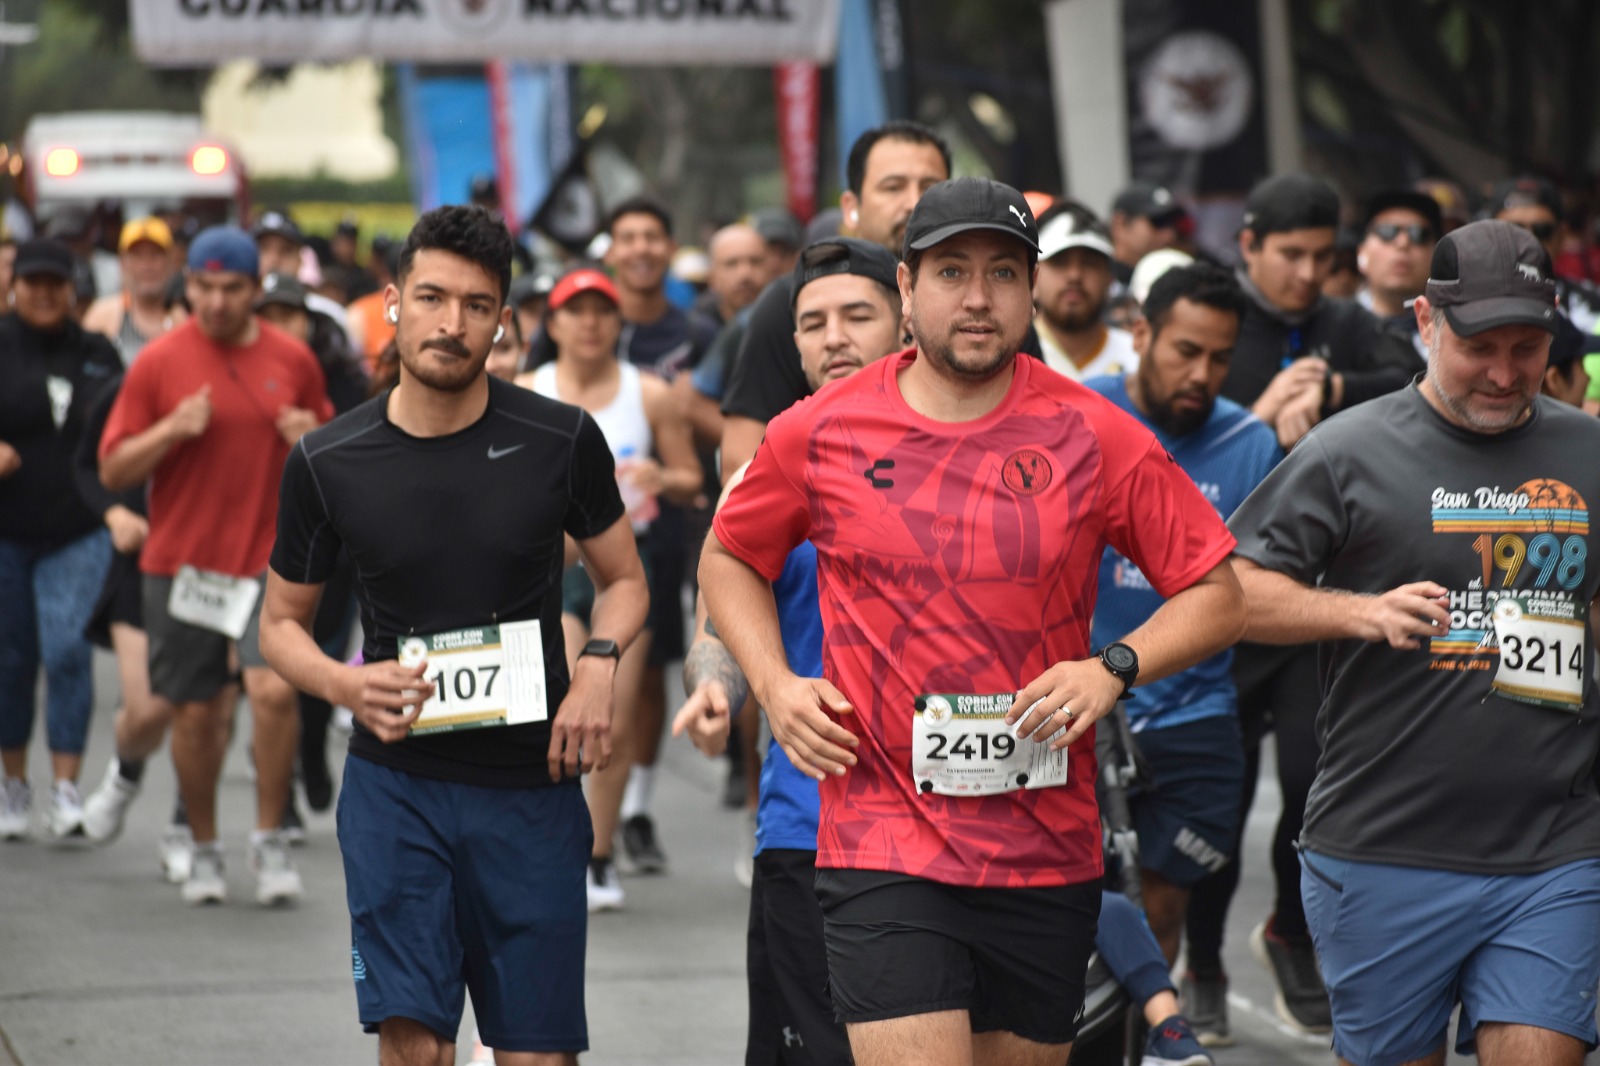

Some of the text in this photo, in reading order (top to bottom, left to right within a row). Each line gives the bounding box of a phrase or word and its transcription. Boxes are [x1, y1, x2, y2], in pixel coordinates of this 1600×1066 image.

[1431, 486, 1530, 514] San Diego
[1472, 533, 1588, 590] 1998
[1444, 591, 1482, 609] HE
[1527, 599, 1575, 610] CORRE CON
[433, 629, 483, 643] CORRE CON
[1503, 635, 1582, 679] 3214
[431, 665, 501, 702] 107
[958, 694, 1013, 705] CORRE CON
[958, 704, 971, 714] TU
[926, 733, 1015, 760] 2419
